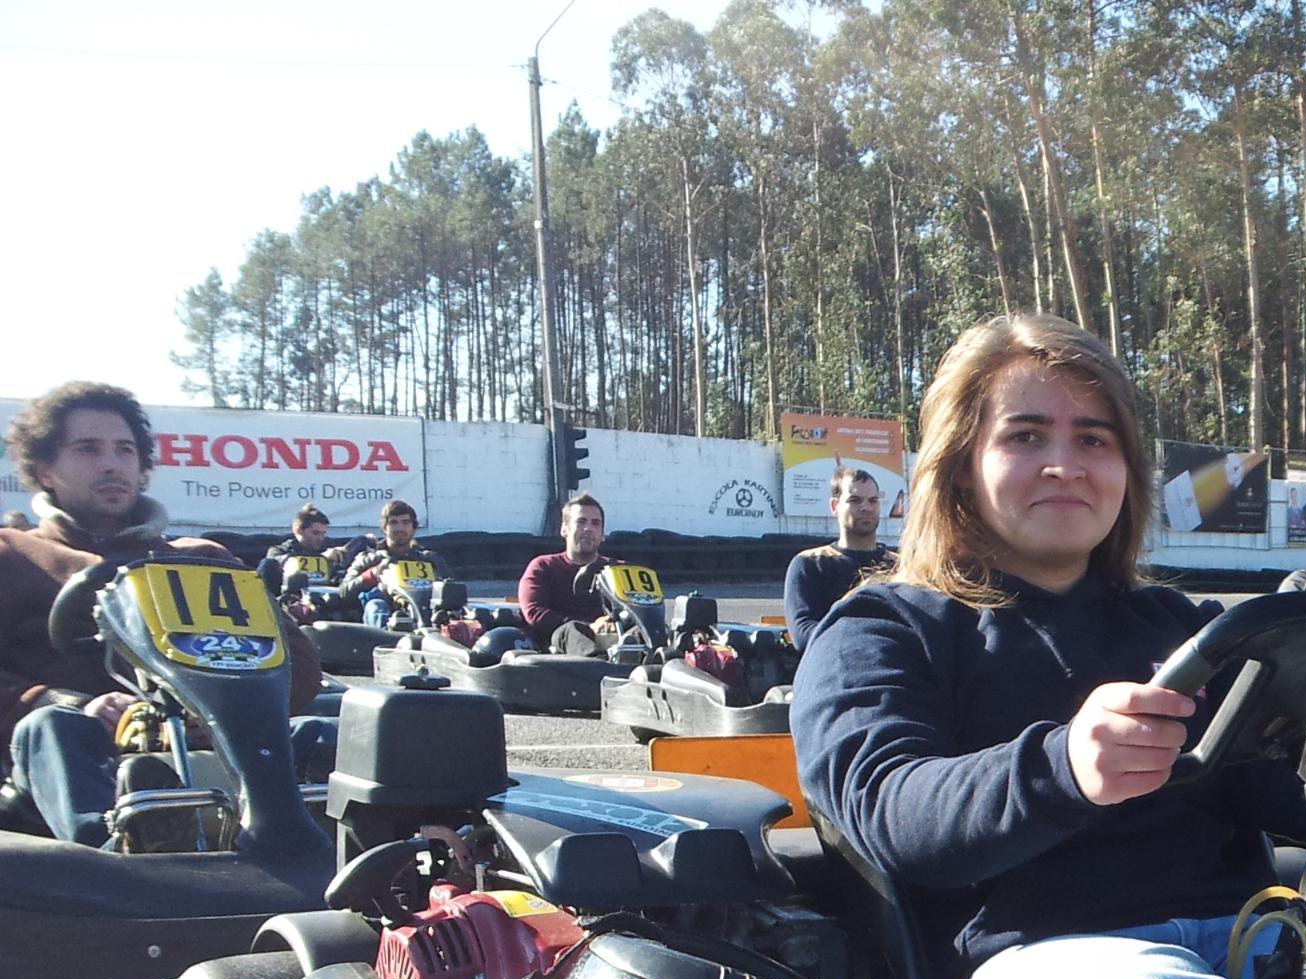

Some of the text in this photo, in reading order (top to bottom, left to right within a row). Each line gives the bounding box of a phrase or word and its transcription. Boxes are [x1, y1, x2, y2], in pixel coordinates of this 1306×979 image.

[154, 433, 409, 472] HONDA
[182, 480, 394, 500] The Power of Dreams
[300, 558, 321, 571] 21
[404, 562, 428, 579] 13
[622, 569, 655, 592] 19
[166, 569, 250, 627] 14
[200, 636, 241, 650] 24
